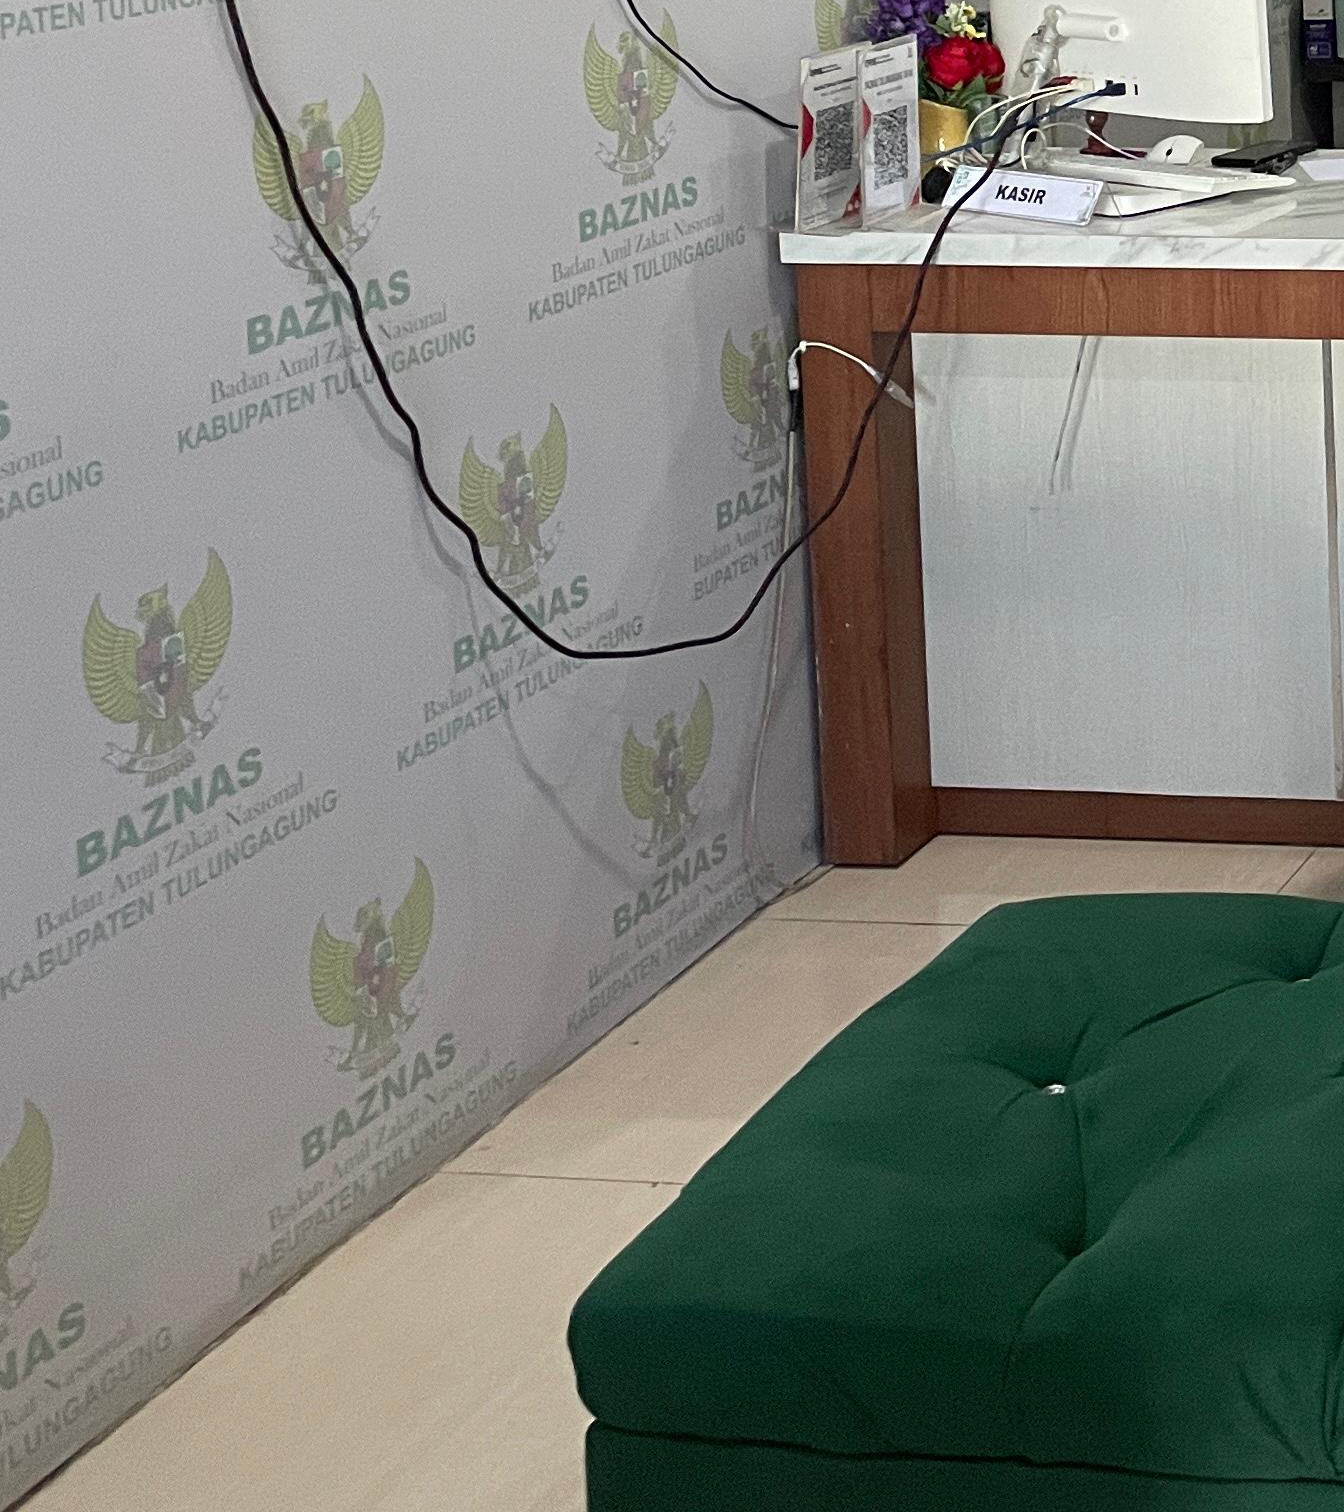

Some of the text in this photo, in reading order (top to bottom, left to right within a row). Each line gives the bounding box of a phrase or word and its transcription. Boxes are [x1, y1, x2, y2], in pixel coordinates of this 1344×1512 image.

[552, 204, 725, 283] Badan Amil Zakat Nasional
[577, 174, 698, 244] BAZNAS
[995, 184, 1047, 205] KASIR
[527, 224, 746, 323] KABUPATEN TULUNGAGUNG
[208, 361, 269, 404] Badan
[275, 344, 319, 381] Amil
[378, 301, 449, 346] Nasional
[174, 380, 316, 453] KABUPATEN
[714, 466, 792, 533] BAZN
[692, 548, 759, 602] BUPATEN
[394, 614, 645, 771] KABUPATEN TULUNGGUNG
[515, 636, 547, 673] Zak
[34, 769, 304, 941] Badan Amil Zakat Nasional
[74, 743, 263, 879] BAZNAS
[161, 785, 337, 907] TULUNGAGUNG
[611, 829, 728, 941] BAZNAS
[300, 1027, 456, 1172] BAZNAS
